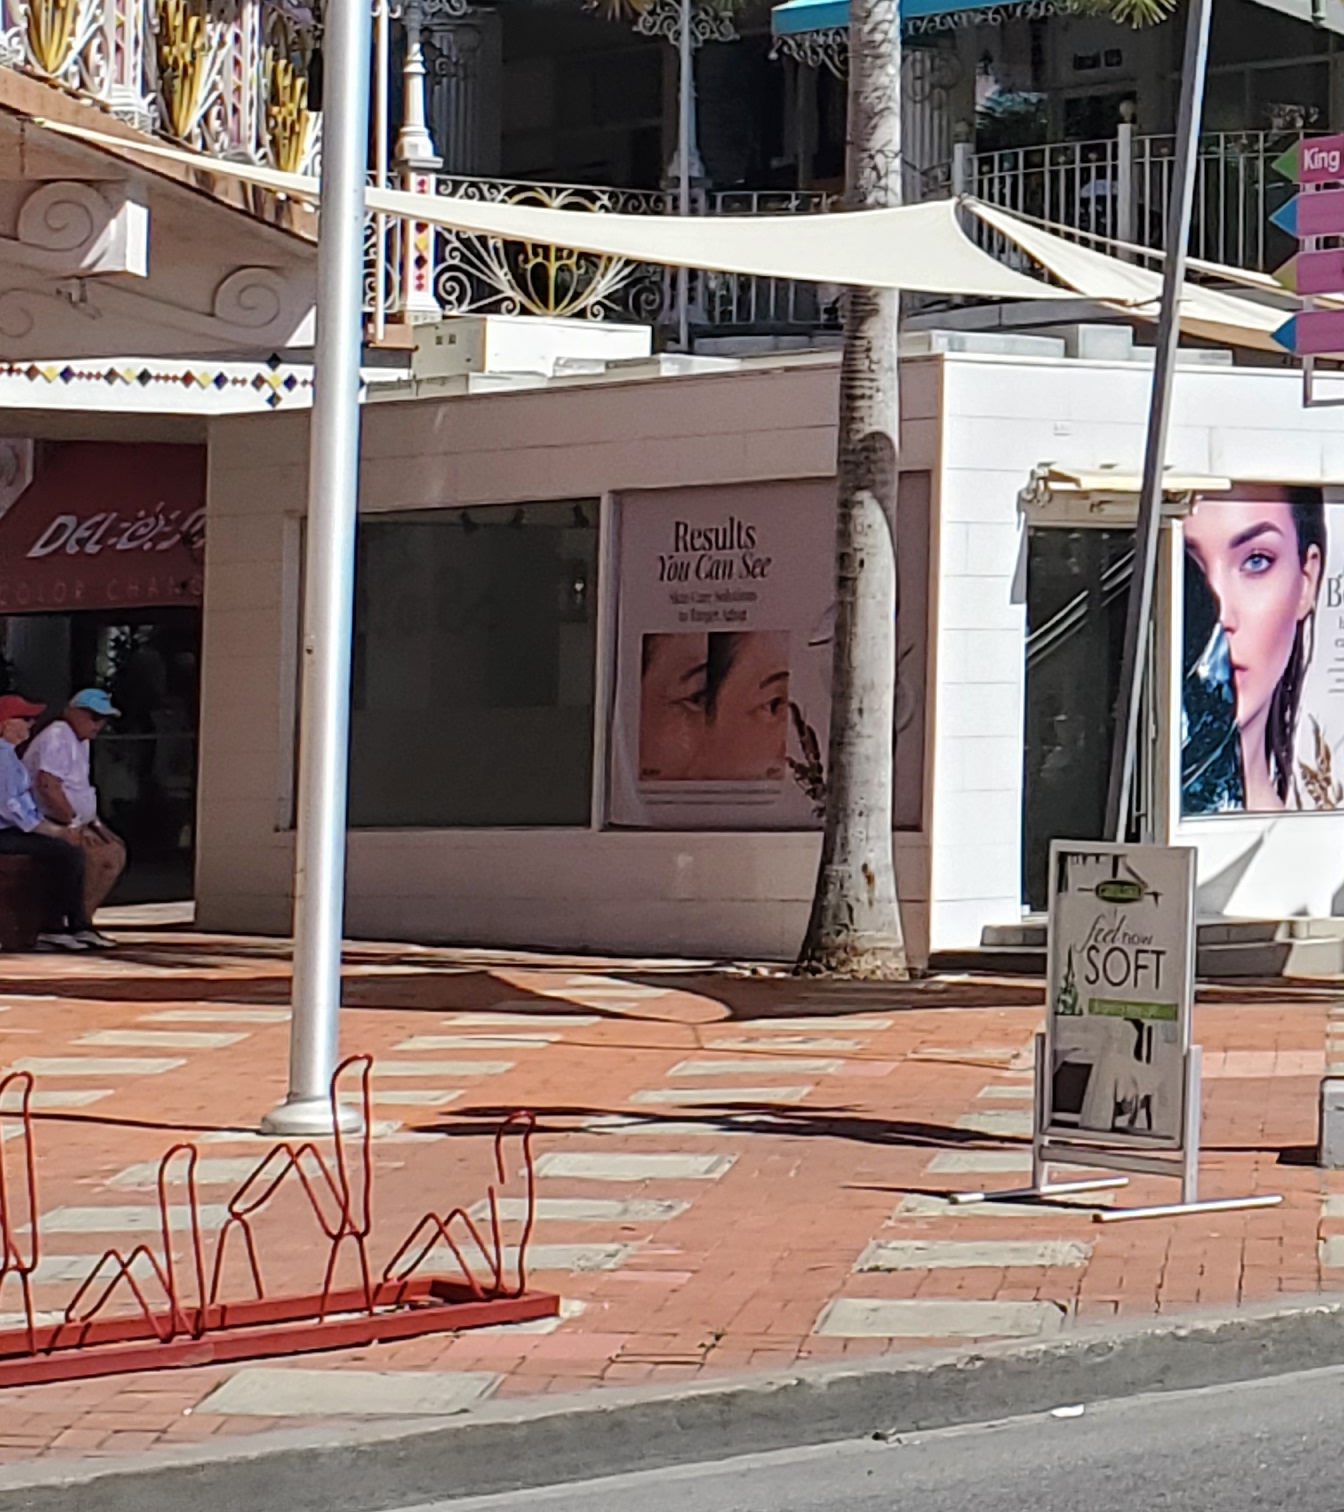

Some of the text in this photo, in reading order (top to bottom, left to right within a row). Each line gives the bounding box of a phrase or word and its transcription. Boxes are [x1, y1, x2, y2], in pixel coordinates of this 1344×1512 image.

[1304, 147, 1340, 173] King
[675, 516, 756, 552] Results
[658, 551, 772, 582] You Can See
[1085, 943, 1167, 990] SOFT
